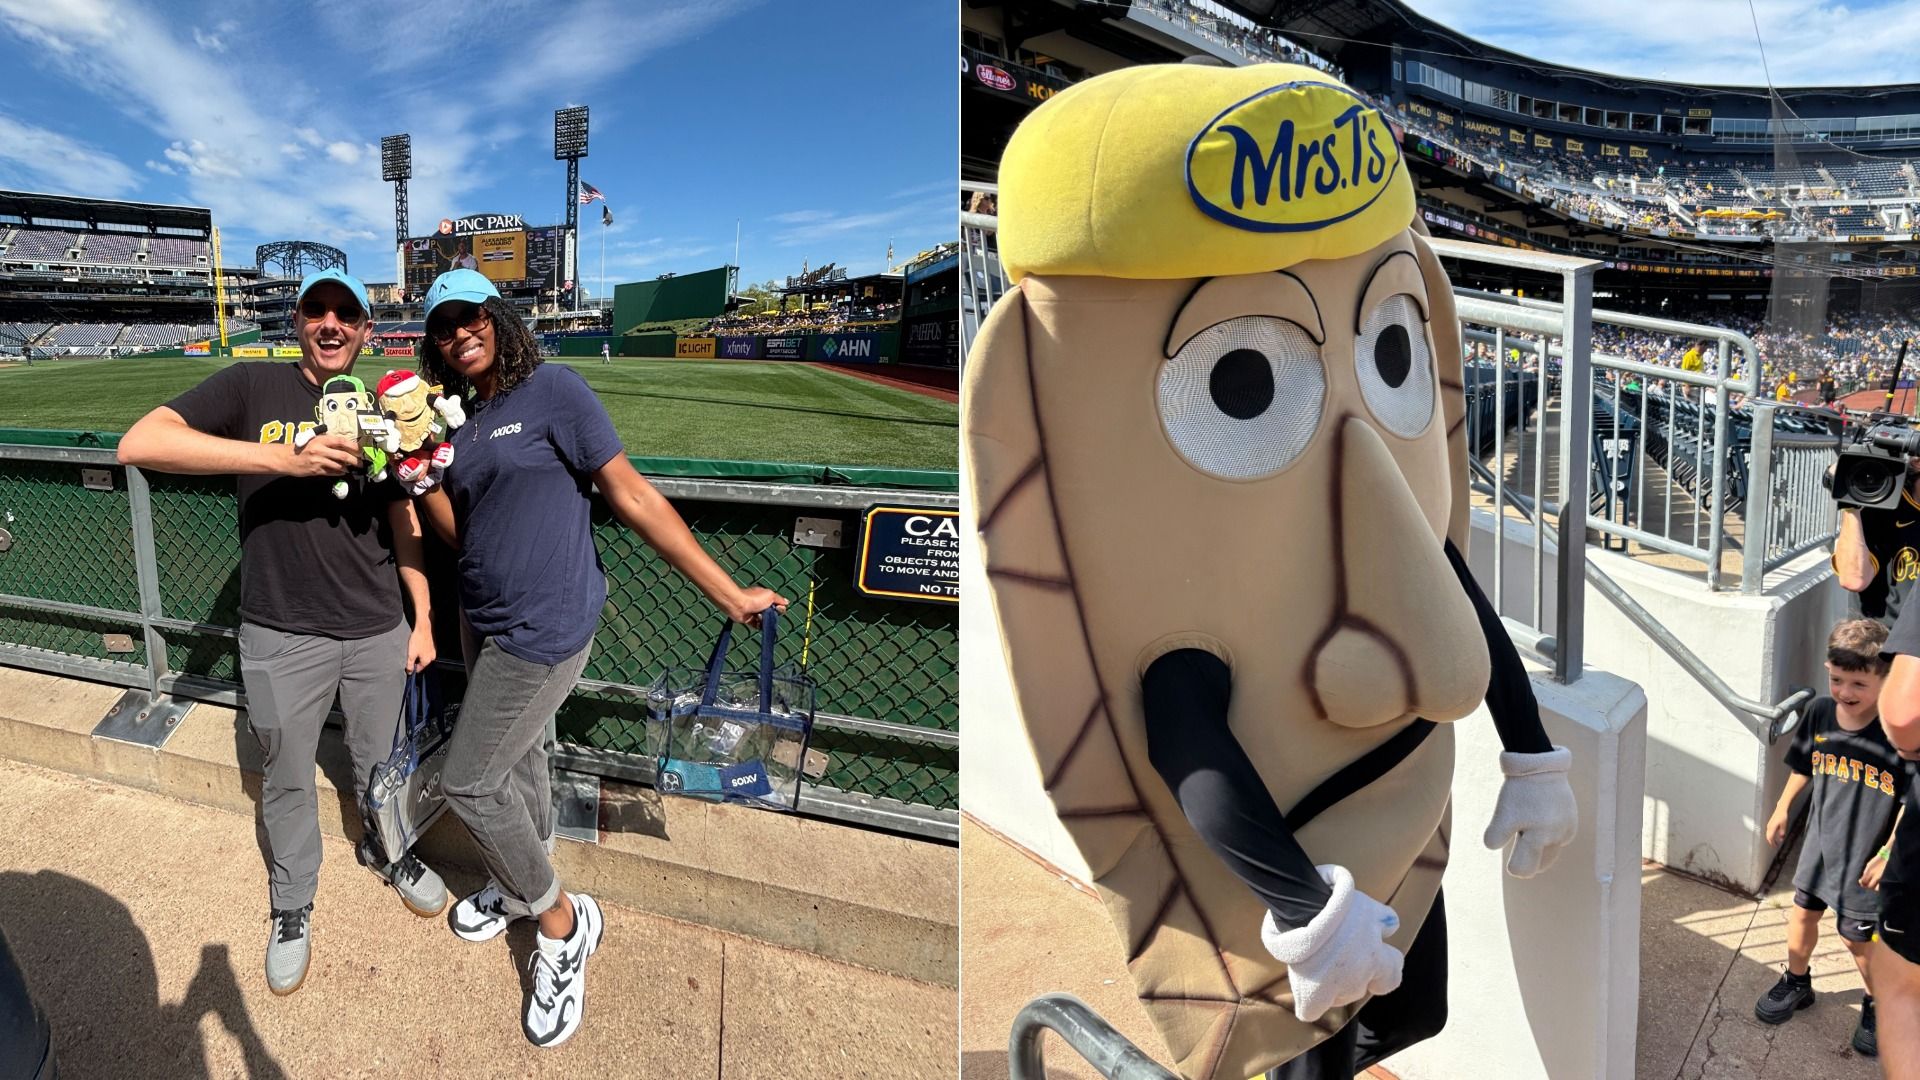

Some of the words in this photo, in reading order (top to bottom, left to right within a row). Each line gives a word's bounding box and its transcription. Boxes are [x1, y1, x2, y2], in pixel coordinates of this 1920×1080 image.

[1409, 102, 1431, 118] WORLD
[1437, 111, 1454, 125] SERIES
[455, 217, 484, 232] PNC
[487, 214, 522, 229] PARK
[385, 348, 413, 356] SEATGEEK
[688, 343, 712, 353] LIGHT
[727, 341, 751, 356] xfinity
[838, 340, 871, 357] AHN
[489, 422, 522, 440] AXIOS
[901, 537, 947, 548] PLEASE
[927, 549, 959, 558] FROM
[885, 555, 938, 567] OBJECTS
[879, 565, 894, 573] TO
[896, 567, 930, 576] MOVE
[932, 570, 959, 578] AND
[920, 584, 941, 593] NO
[1811, 750, 1895, 796] PIRATES
[731, 773, 757, 787] AXIOS
